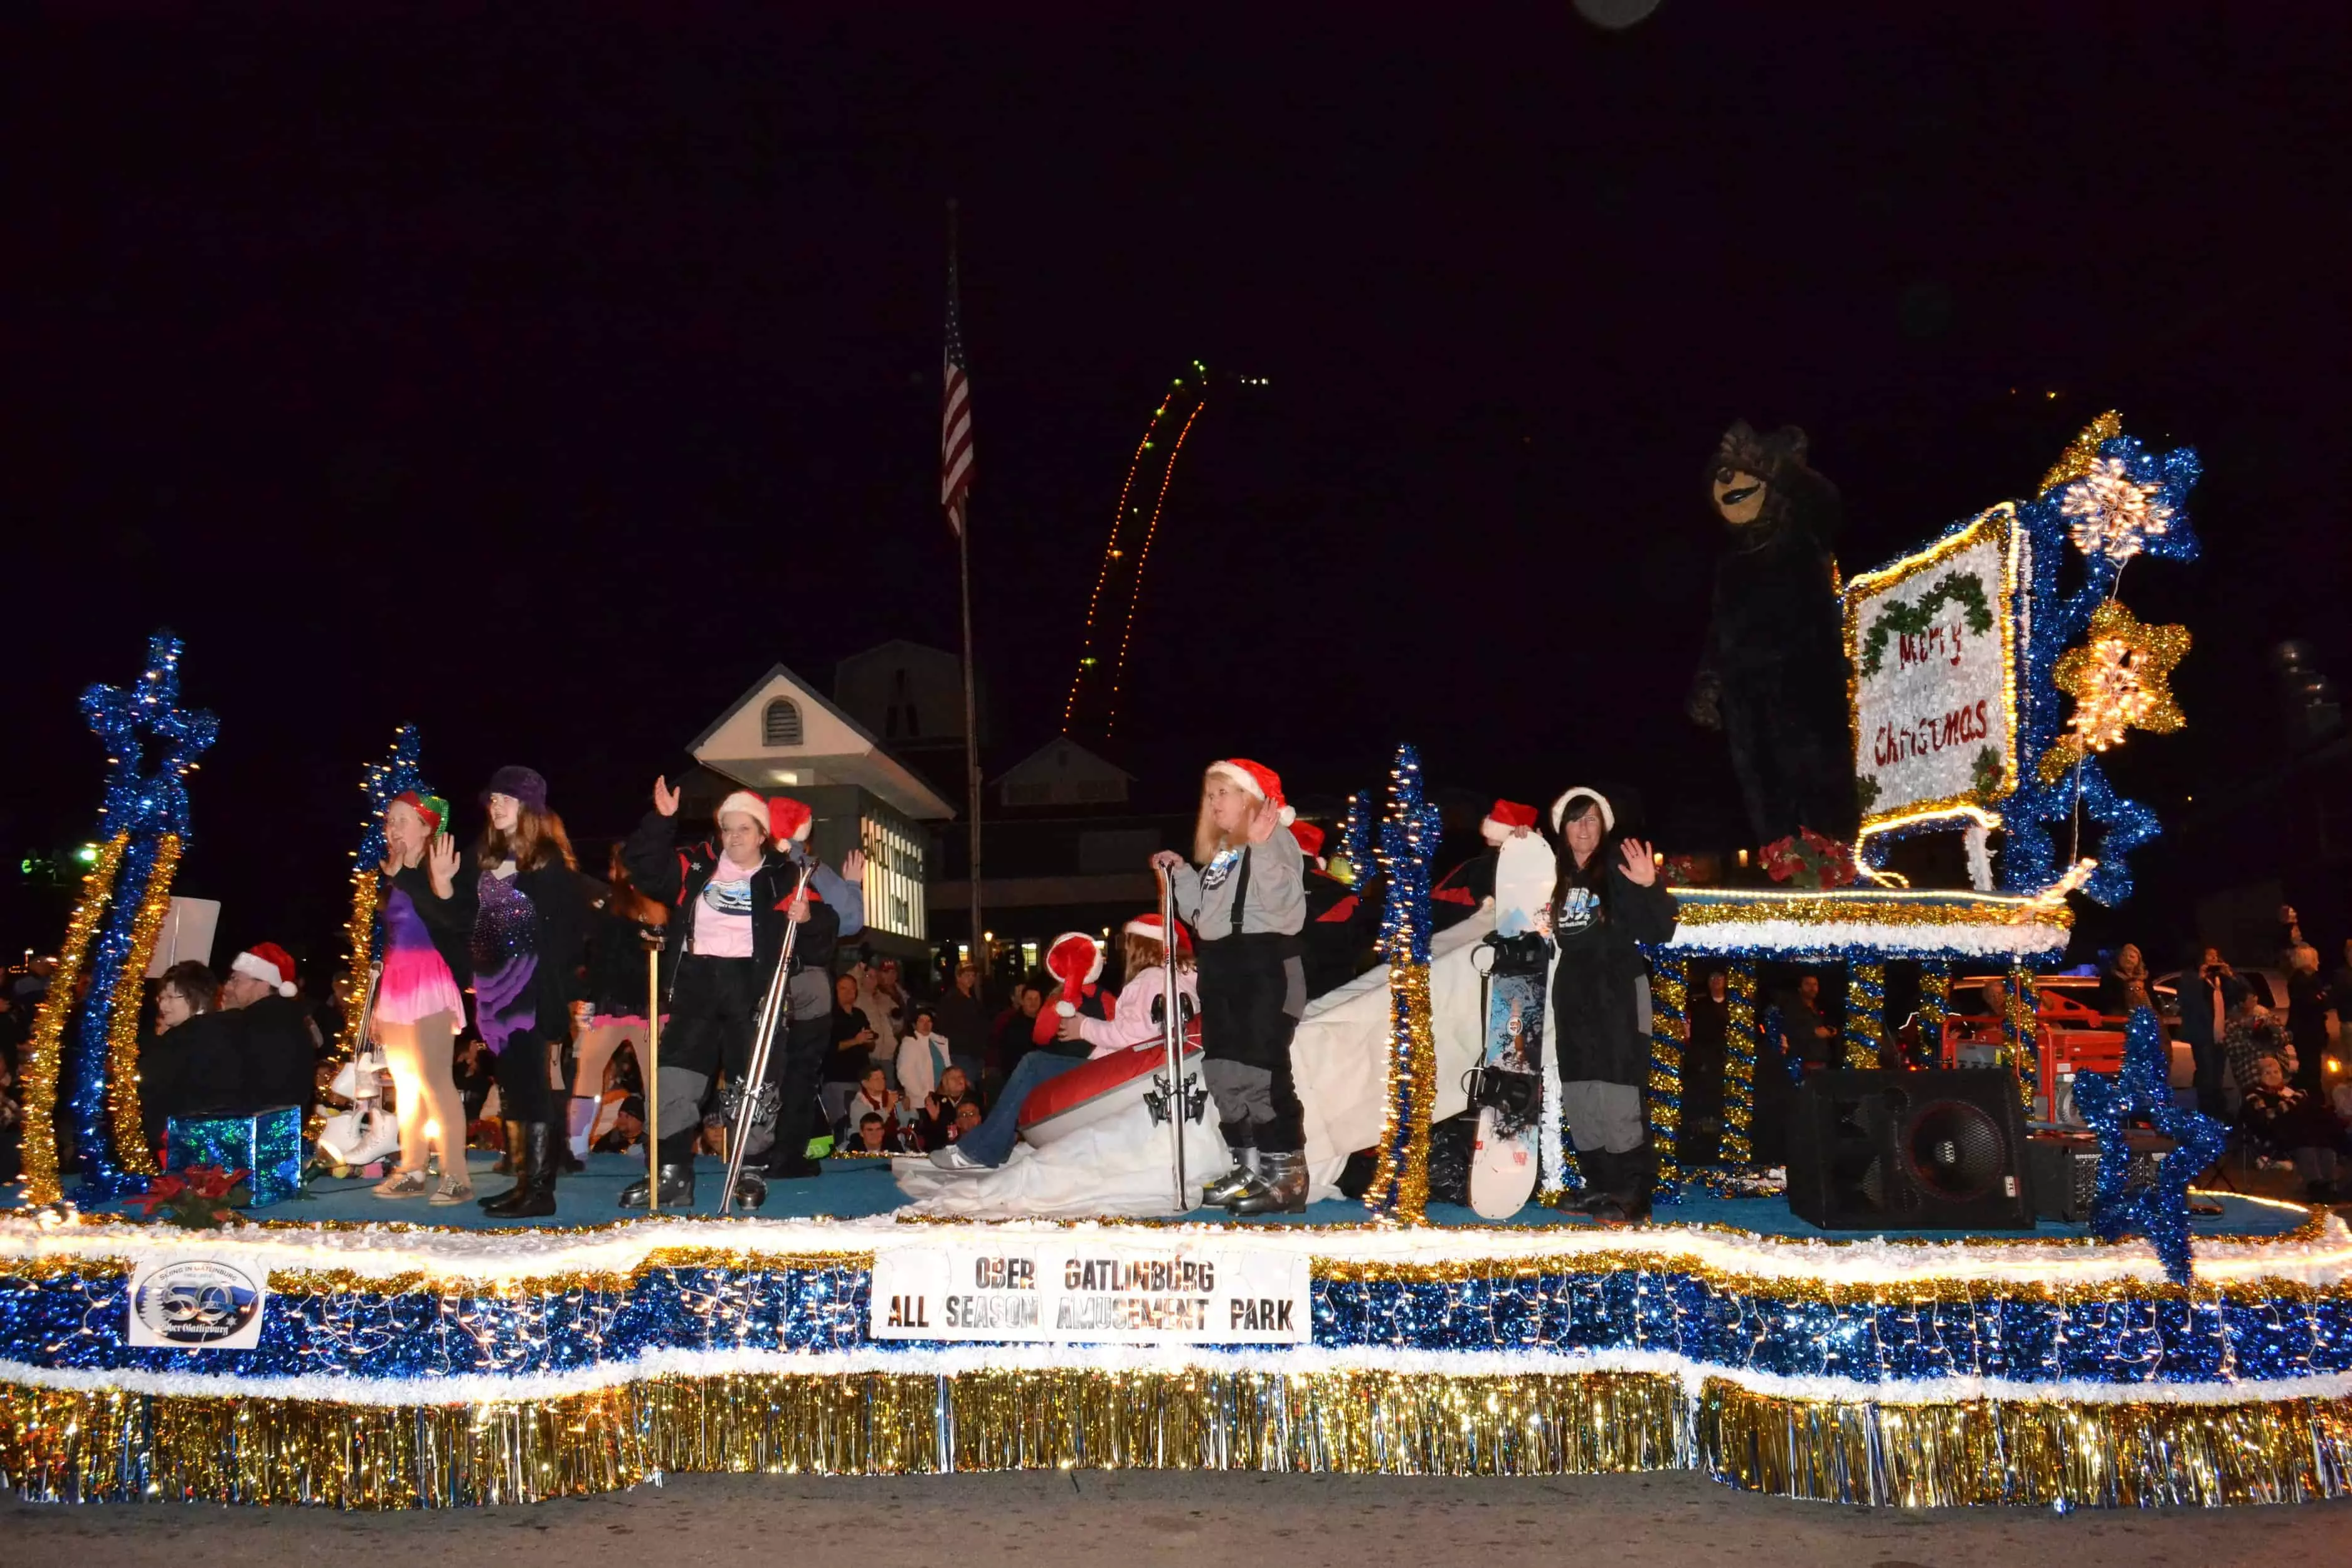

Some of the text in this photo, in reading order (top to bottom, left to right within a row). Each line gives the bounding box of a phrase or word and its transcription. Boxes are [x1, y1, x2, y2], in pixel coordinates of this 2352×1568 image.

[159, 1267, 183, 1281] SKIING
[975, 1256, 1216, 1293] OBER GATLINBURG
[162, 1281, 233, 1322] 50
[887, 1295, 1295, 1332] ALL SEASON AMUSEMENT PARK
